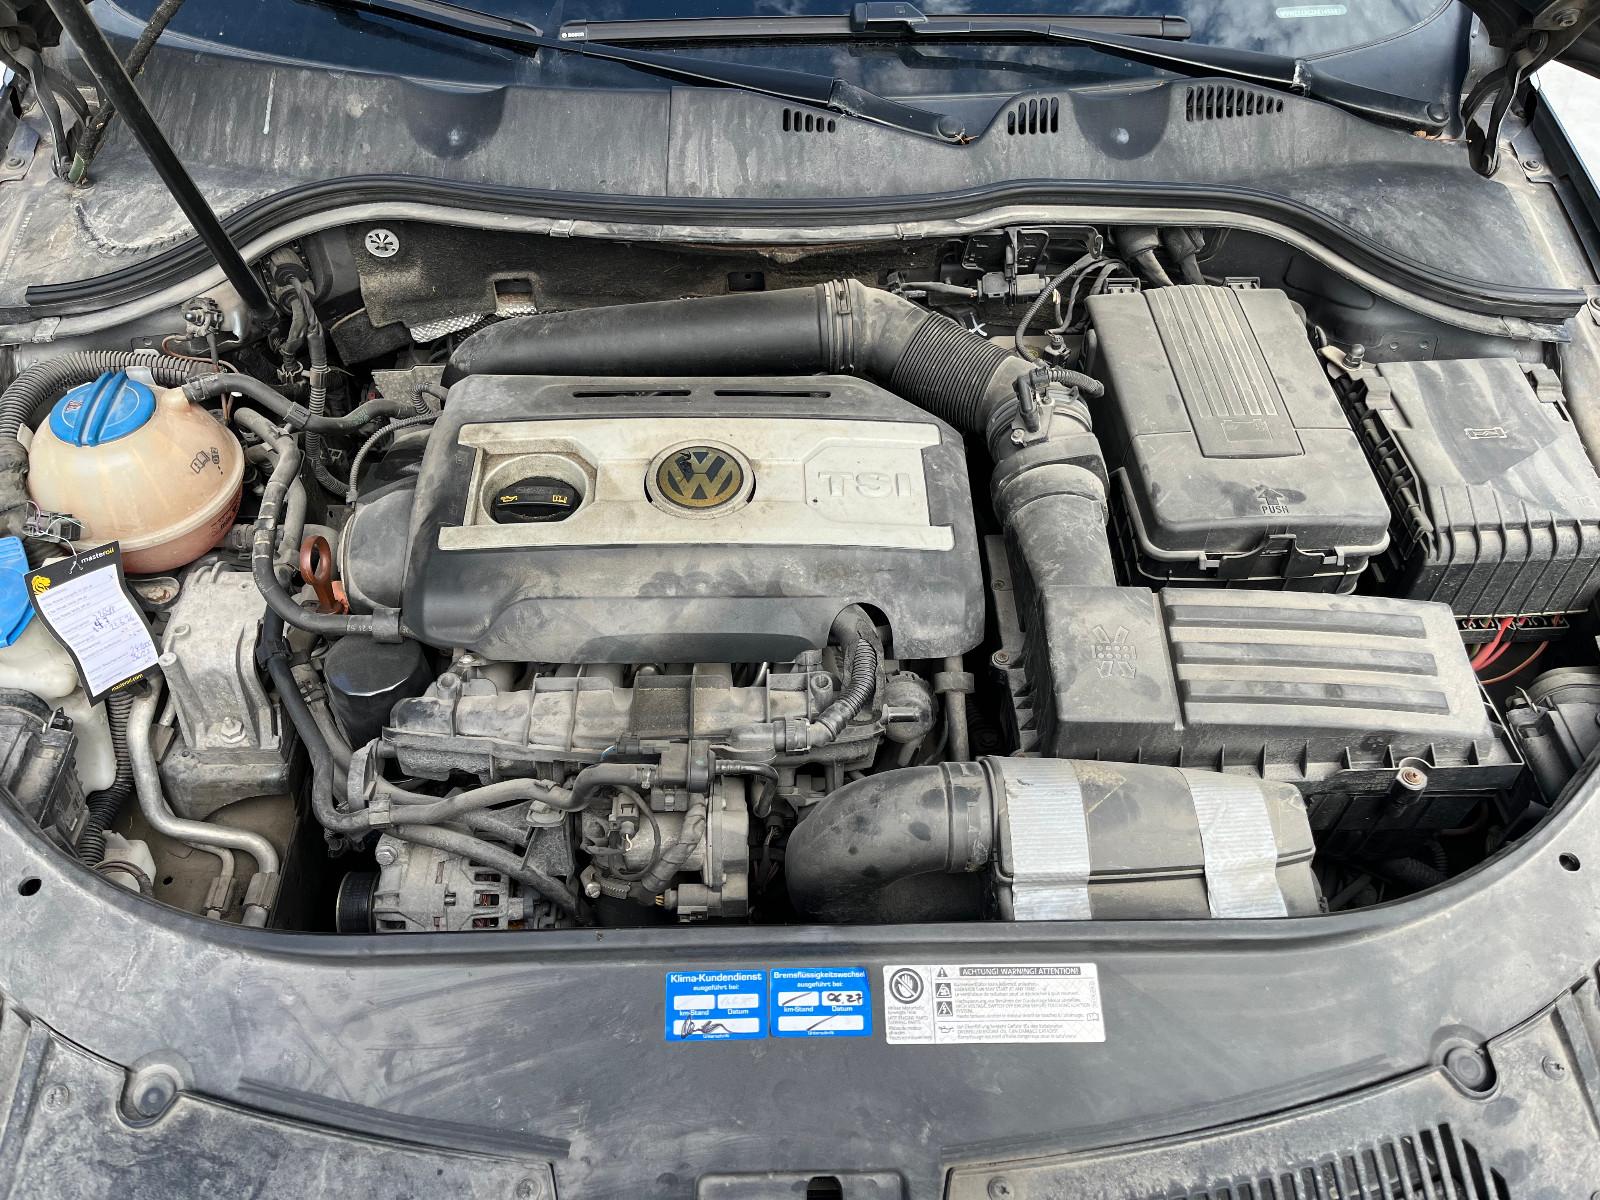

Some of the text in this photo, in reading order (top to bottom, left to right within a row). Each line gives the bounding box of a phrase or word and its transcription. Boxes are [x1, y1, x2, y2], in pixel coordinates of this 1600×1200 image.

[818, 471, 912, 498] TSI
[1261, 505, 1290, 514] PUSH
[80, 547, 115, 563] masteroil
[773, 970, 866, 980] Bremsflüssigkeitswechsel
[962, 966, 1080, 976] ACHTUNG! WARNING! ATTENTION!
[670, 972, 763, 983] Klima-Kundendienst
[692, 984, 728, 992] ausgeführt
